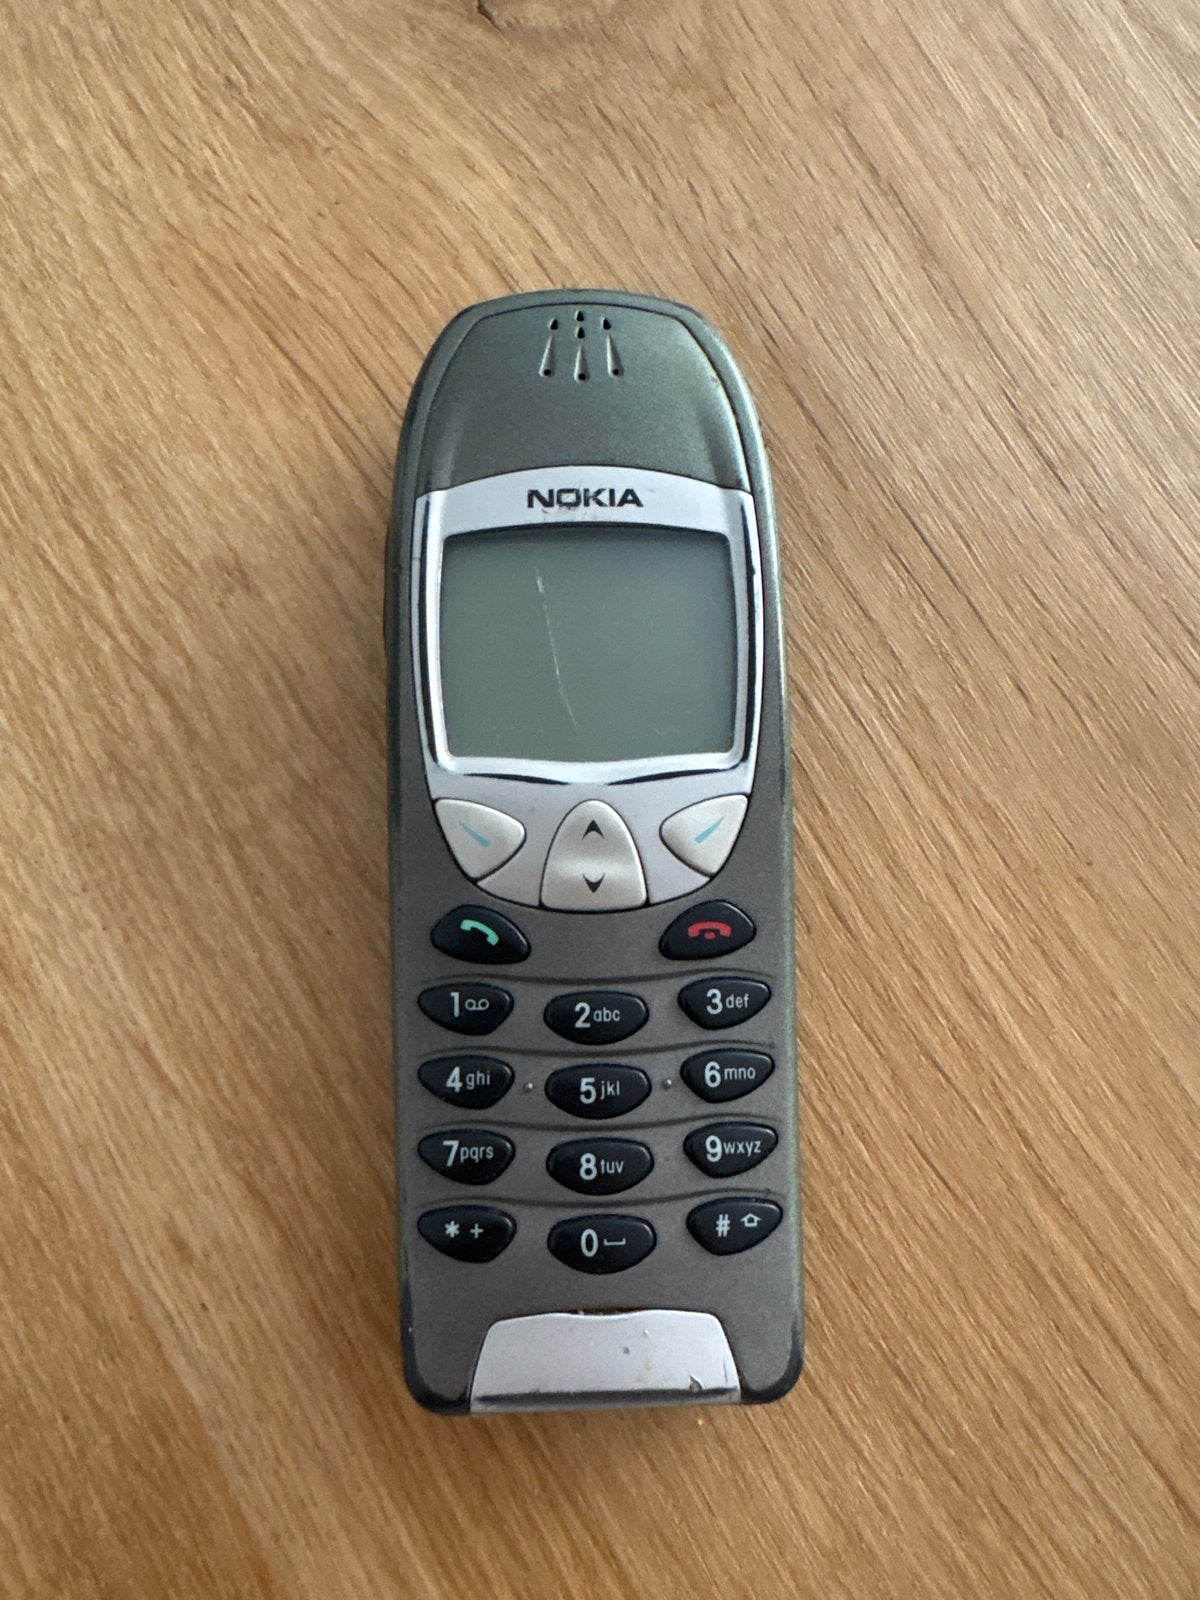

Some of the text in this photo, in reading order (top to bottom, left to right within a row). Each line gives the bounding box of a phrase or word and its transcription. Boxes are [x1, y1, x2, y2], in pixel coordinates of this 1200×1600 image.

[527, 488, 644, 508] NOKIA
[451, 992, 459, 1016] 1
[707, 989, 749, 1014] 3 def
[575, 1002, 620, 1027] 2 abc
[447, 1067, 491, 1091] 4 ghi
[705, 1061, 756, 1087] 6 mno
[580, 1078, 619, 1103] 5 jkl
[580, 1153, 623, 1180] 8 tuv
[716, 1214, 730, 1236] #
[581, 1229, 598, 1256] 0
